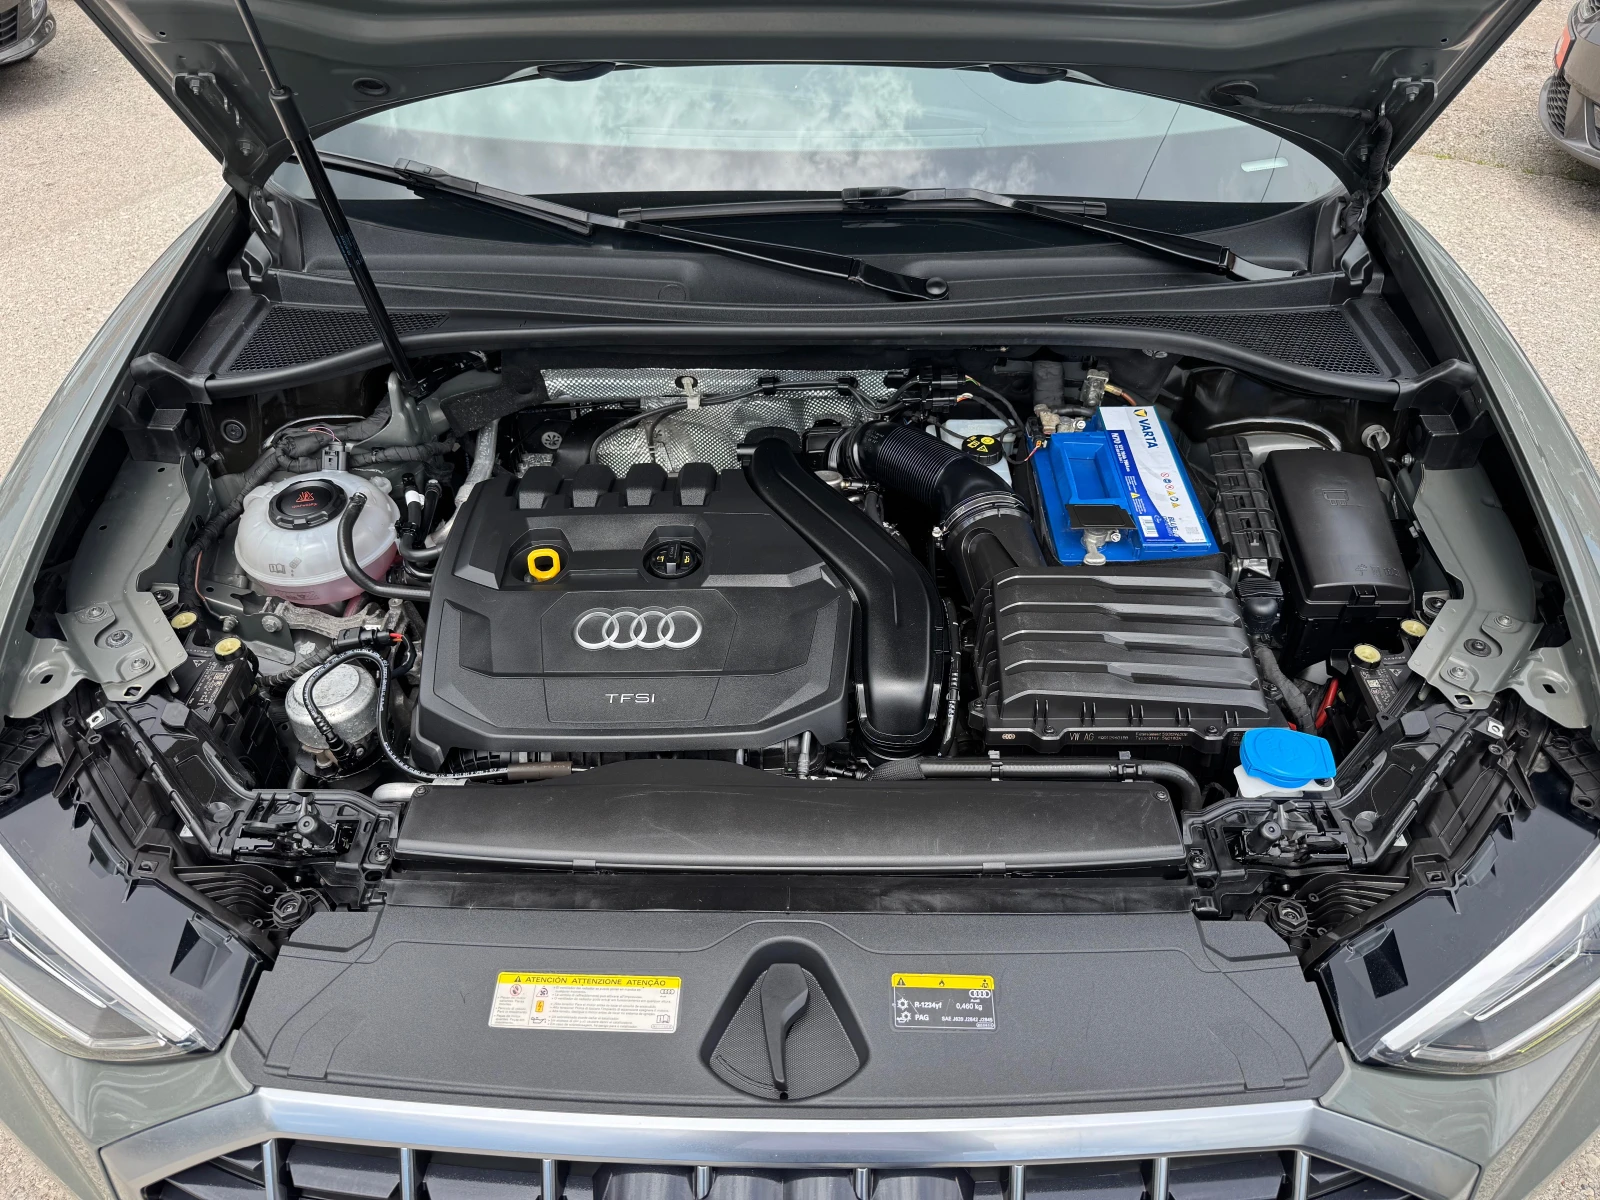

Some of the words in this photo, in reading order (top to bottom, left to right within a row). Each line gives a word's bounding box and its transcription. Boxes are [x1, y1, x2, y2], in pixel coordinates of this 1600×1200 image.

[1139, 418, 1158, 449] VARTA
[605, 693, 655, 704] TFSI
[1069, 732, 1081, 741] VW
[1083, 732, 1095, 741] AG
[525, 975, 568, 984] ATENCIÓN
[571, 977, 622, 985] ATTENZIONE
[626, 978, 666, 987] ATENÇÃO
[914, 1001, 942, 1009] R-1234yf
[955, 1002, 974, 1010] 0,460
[974, 1003, 983, 1011] kg
